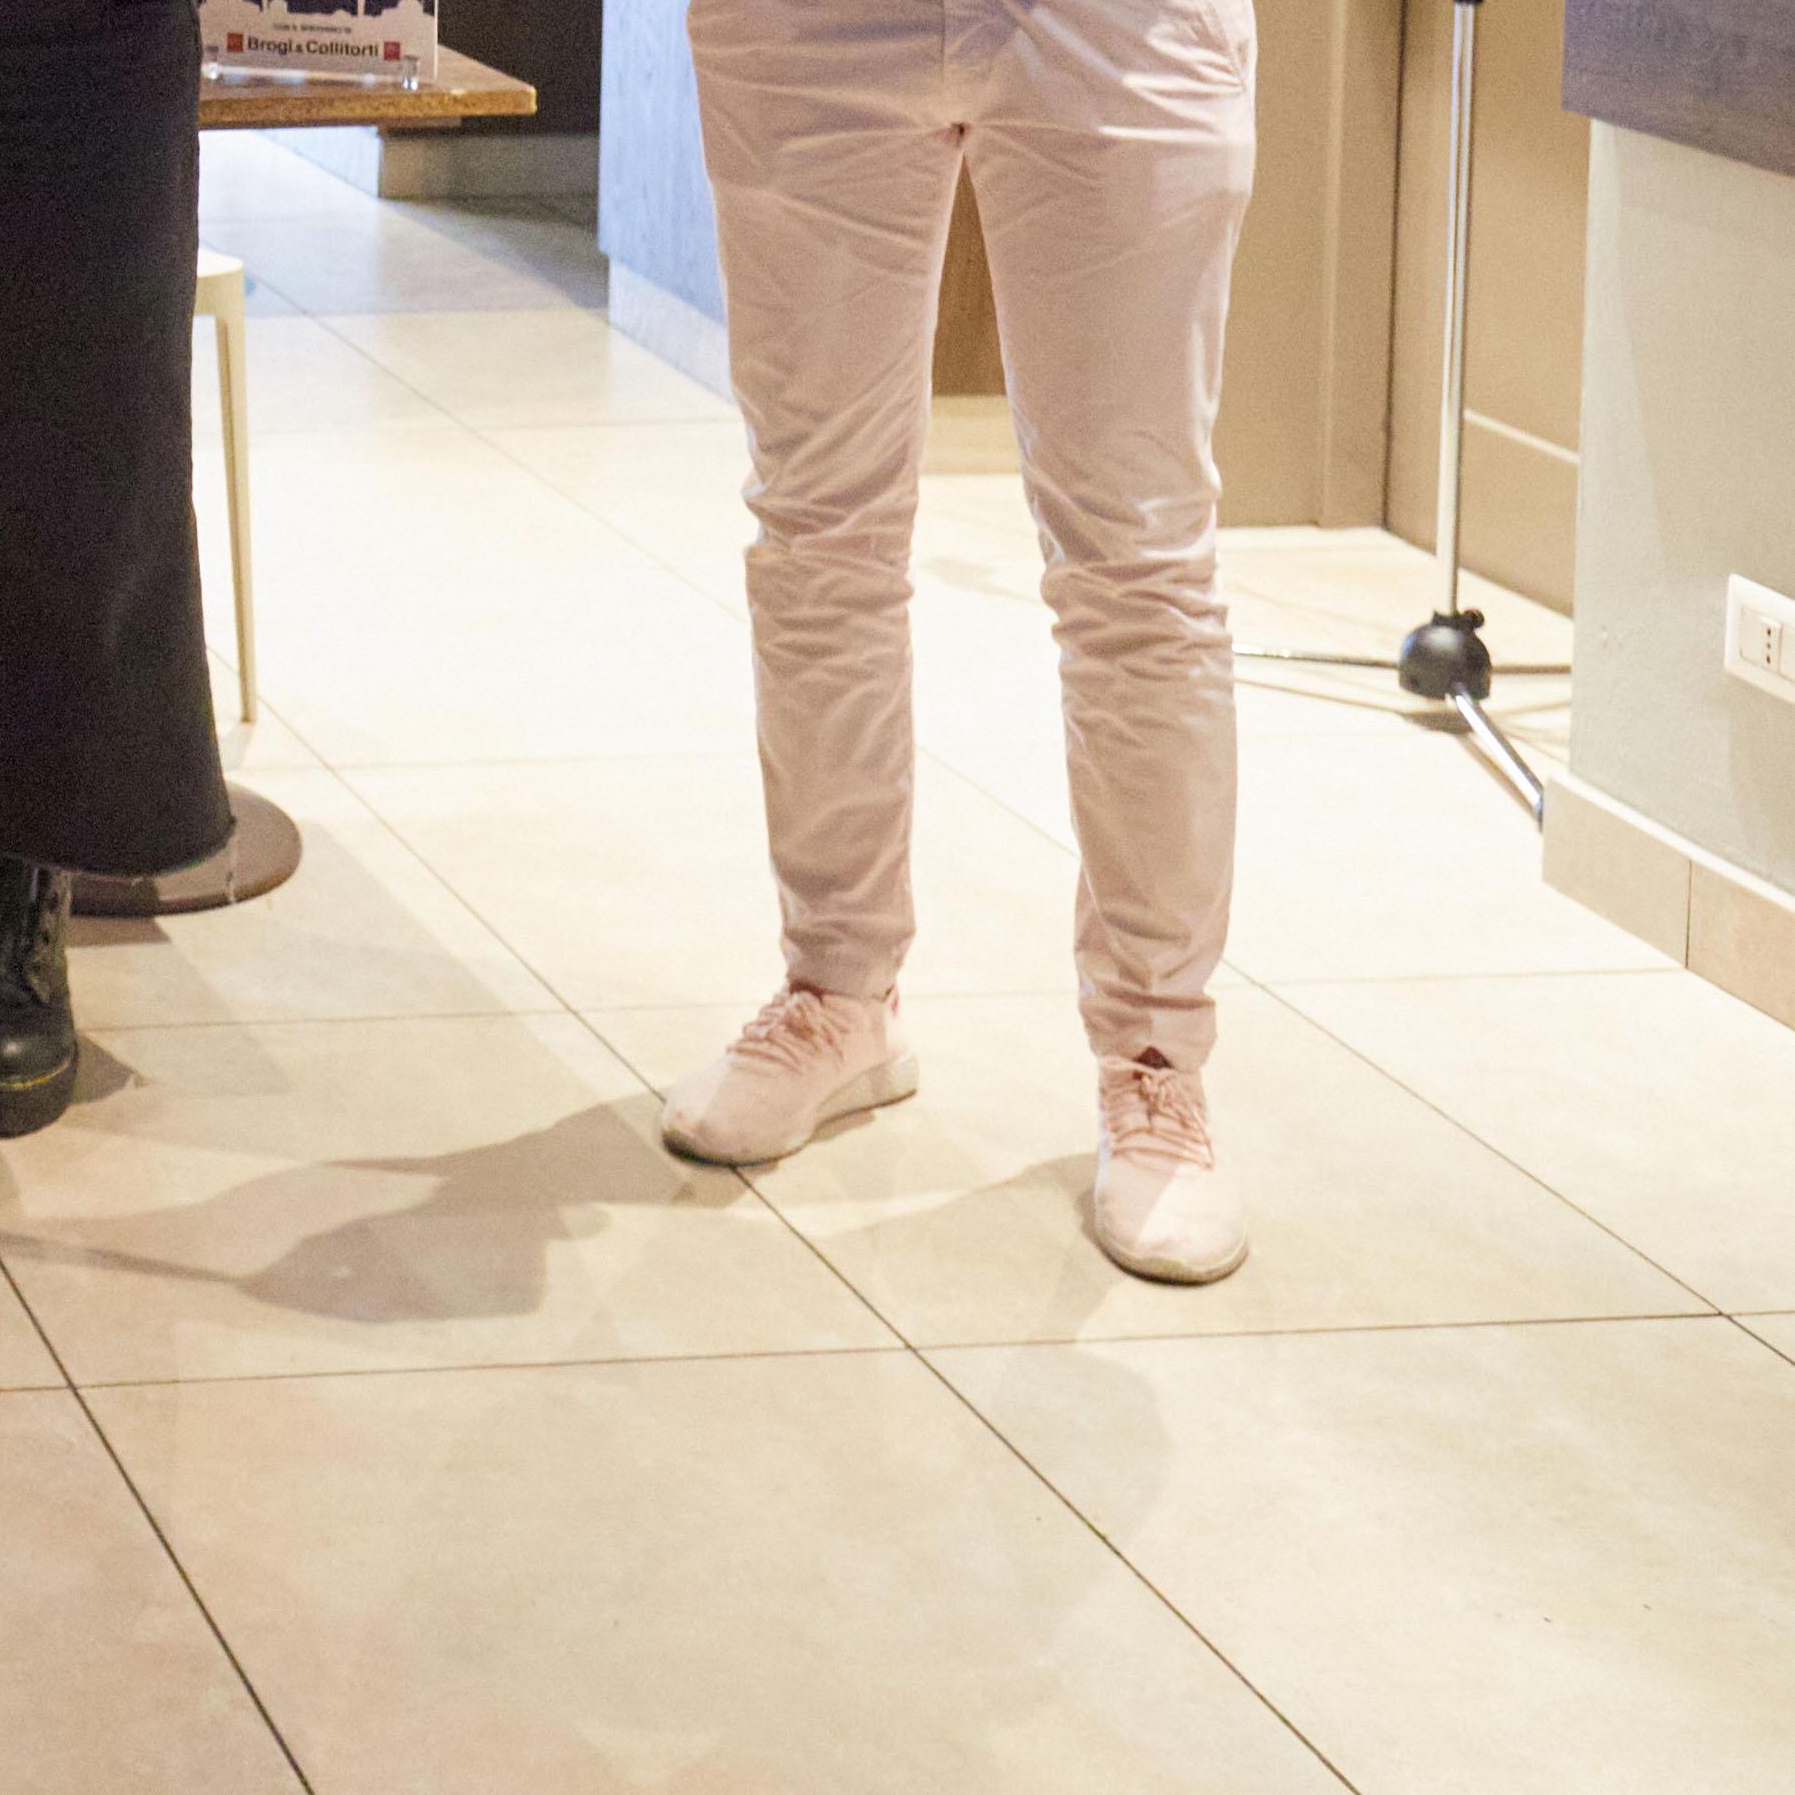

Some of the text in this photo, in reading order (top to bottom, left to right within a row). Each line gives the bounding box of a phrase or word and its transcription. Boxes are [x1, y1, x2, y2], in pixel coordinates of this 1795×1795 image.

[247, 36, 379, 57] Brogi & Collitorti
